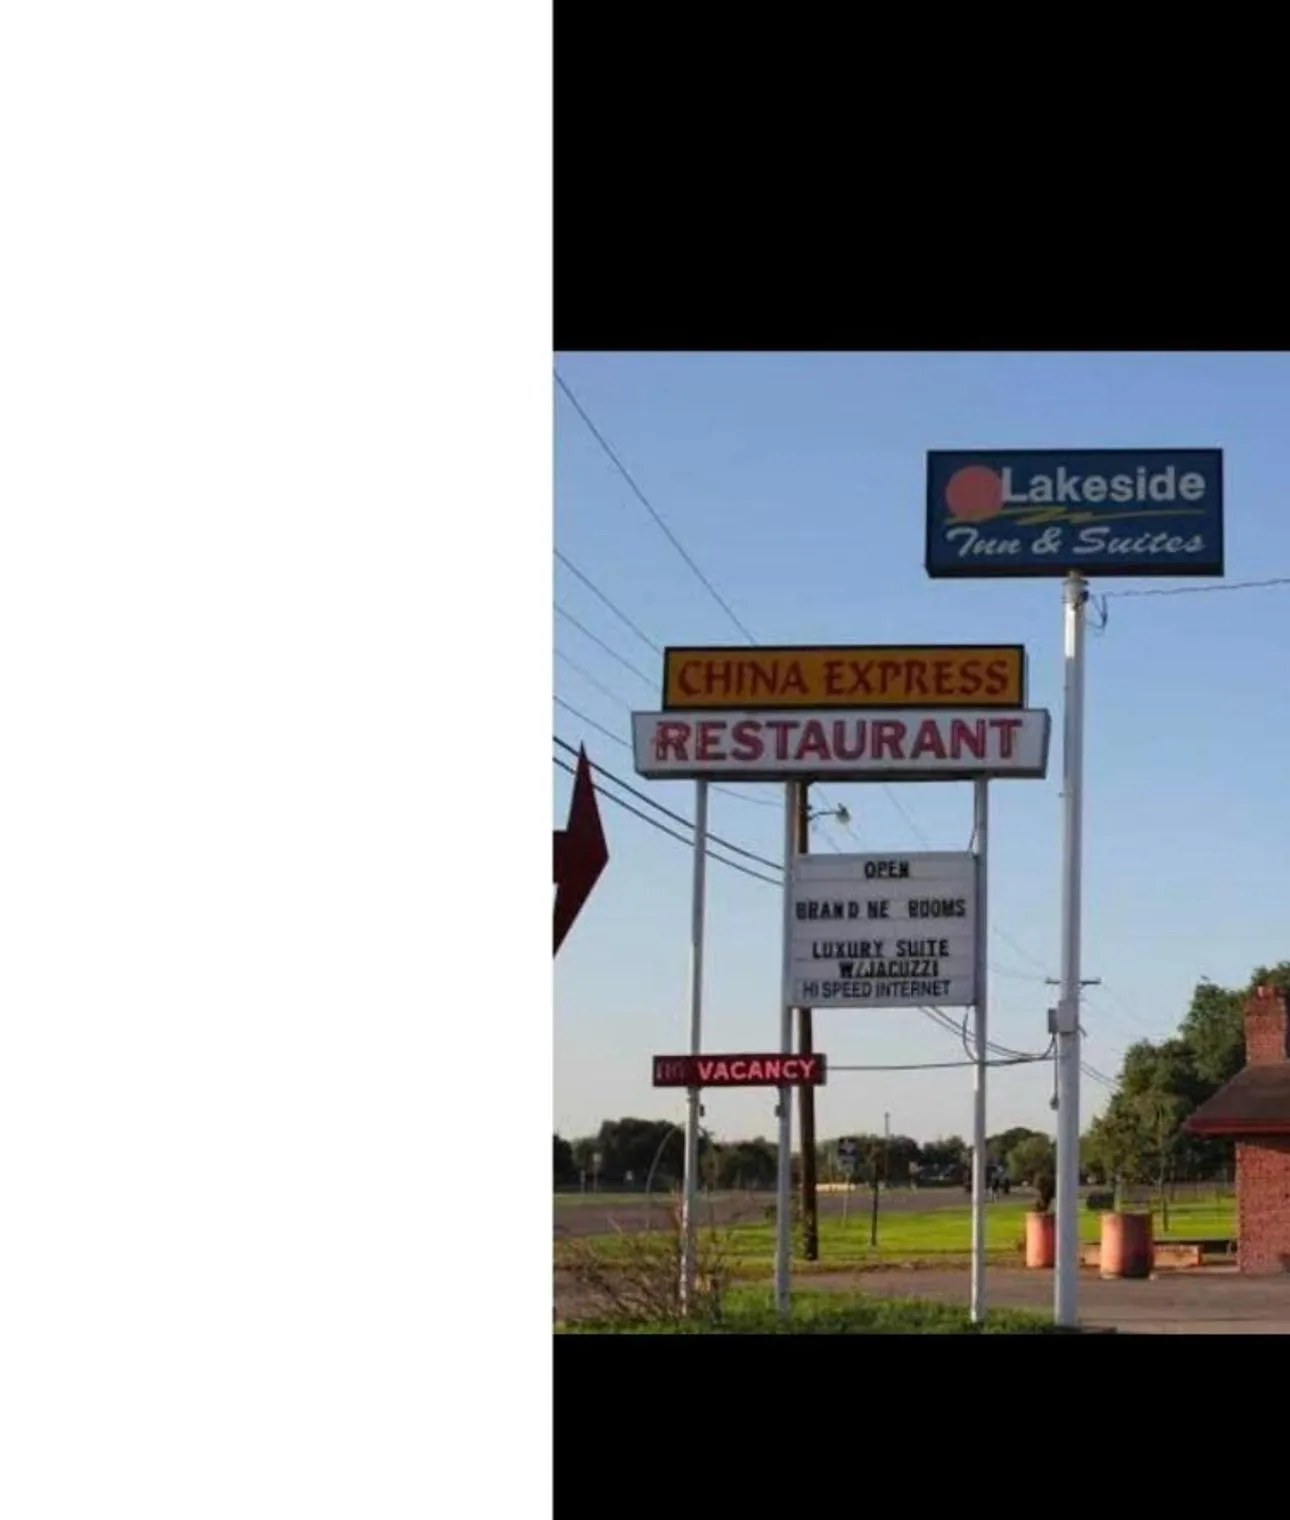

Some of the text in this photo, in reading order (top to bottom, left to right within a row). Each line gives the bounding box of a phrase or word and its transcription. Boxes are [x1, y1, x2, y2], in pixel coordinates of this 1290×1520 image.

[1001, 465, 1206, 502] Lakeside
[945, 526, 1206, 557] Inn & Suites
[677, 658, 1010, 697] CHINA EXPRESS
[654, 718, 1023, 762] RESTAURANT
[864, 860, 910, 879] OPEN
[908, 898, 967, 919] ROOMS
[812, 938, 950, 959] LUXURY SUITE
[838, 959, 939, 979] W/JACUZZI
[802, 979, 952, 998] HI SPEED INTERNET
[696, 1059, 815, 1080] VACANCY
